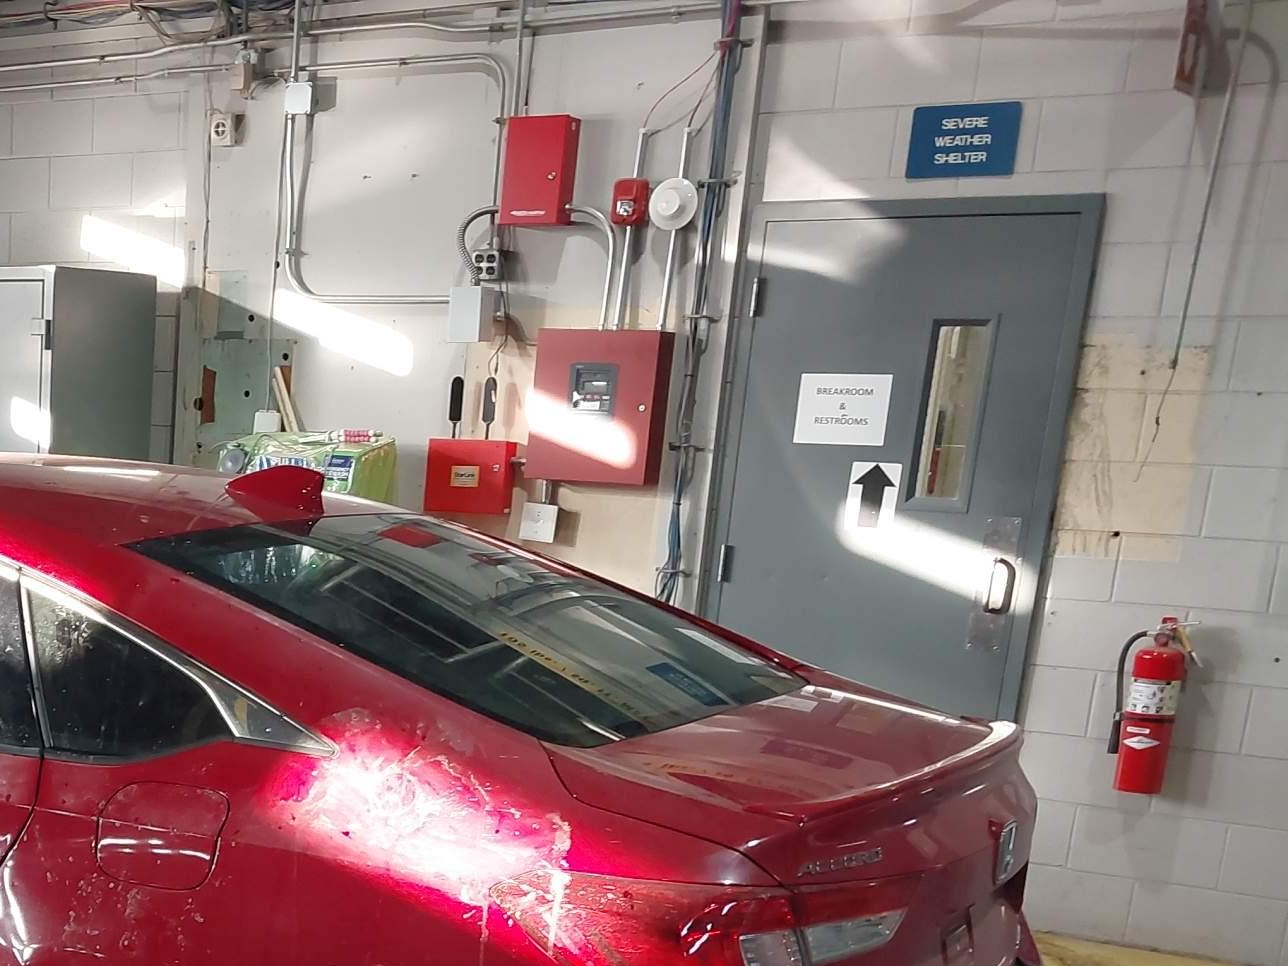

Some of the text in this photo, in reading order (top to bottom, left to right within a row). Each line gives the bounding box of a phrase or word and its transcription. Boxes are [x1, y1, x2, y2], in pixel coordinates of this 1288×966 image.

[942, 116, 989, 129] SEVERE
[934, 134, 992, 147] WEATHER
[933, 151, 987, 164] SHELTER
[816, 387, 874, 396] BREAKROOM
[839, 402, 846, 410] &
[814, 417, 869, 425] RESTROOMS
